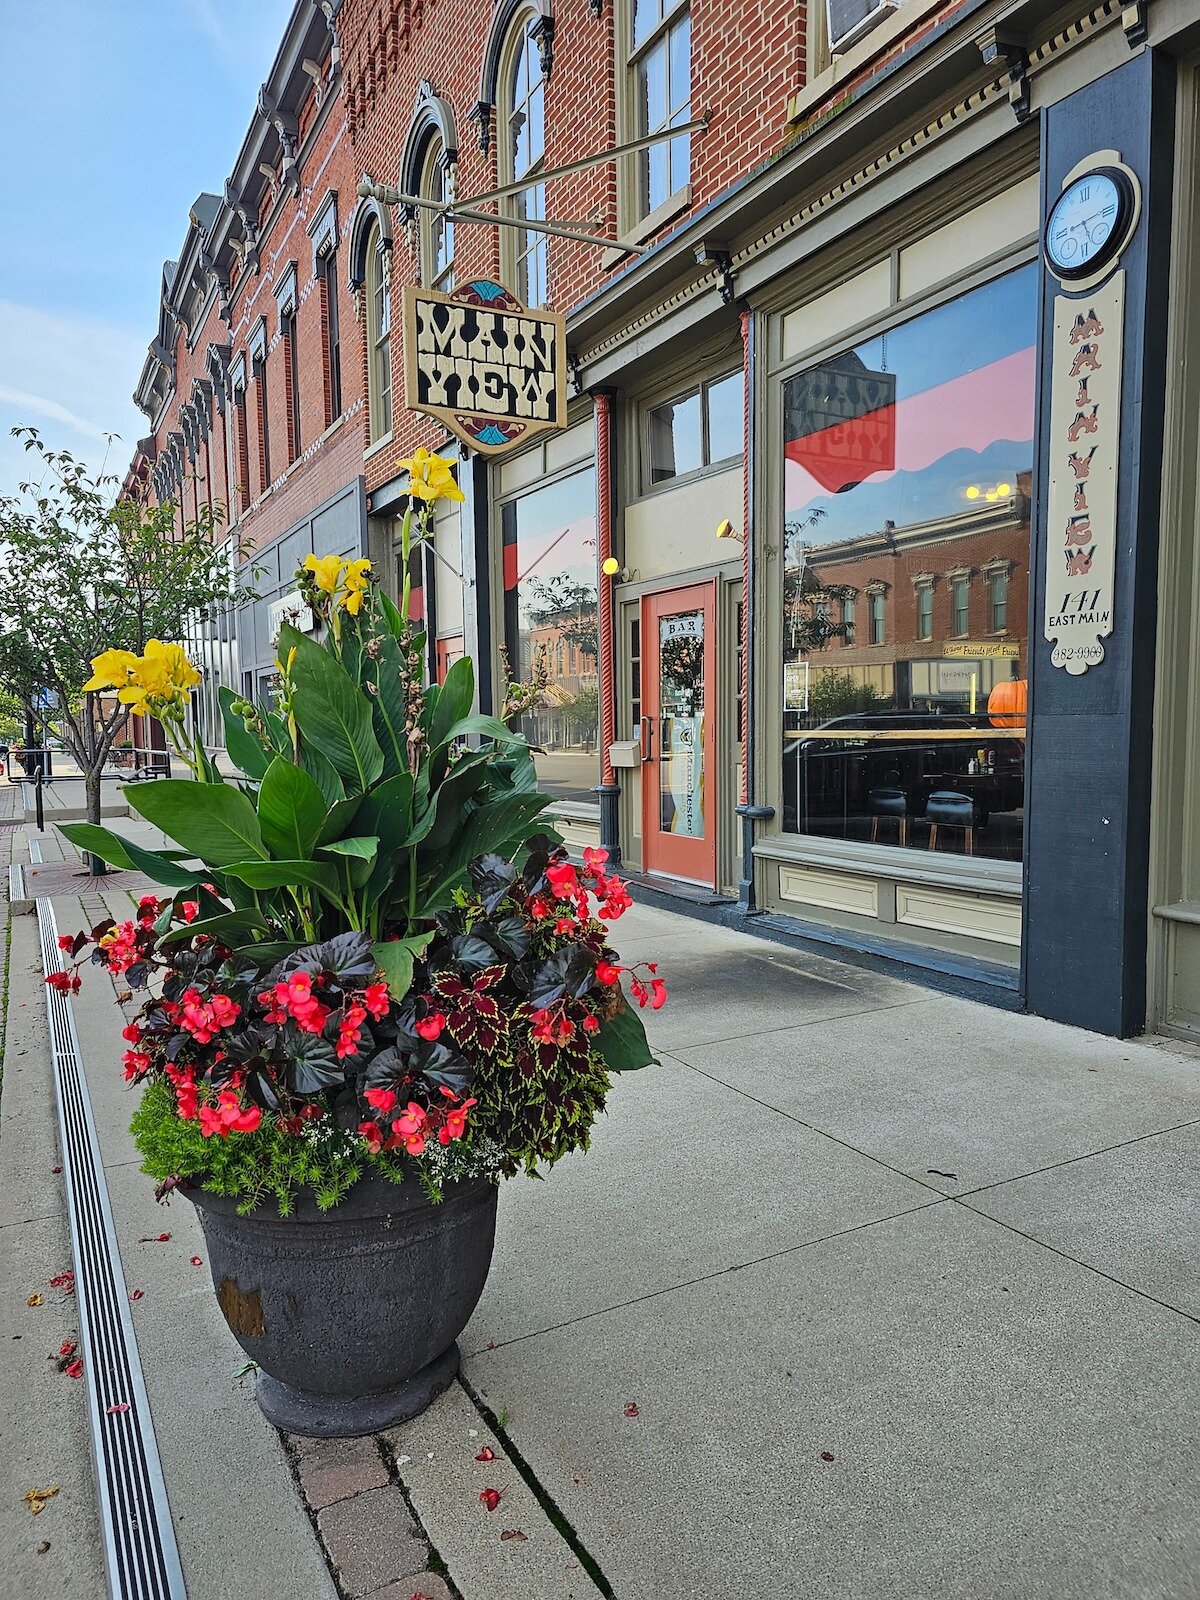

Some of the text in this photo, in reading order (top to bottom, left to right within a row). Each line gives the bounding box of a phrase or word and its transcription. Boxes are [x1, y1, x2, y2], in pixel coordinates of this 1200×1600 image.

[416, 300, 555, 372] MAIN
[418, 352, 555, 420] VIEW
[1060, 588, 1102, 614] 141
[668, 621, 696, 635] BAR
[1049, 611, 1110, 627] EAST MAIN
[963, 645, 985, 656] Friends
[686, 751, 694, 834] Manchester
